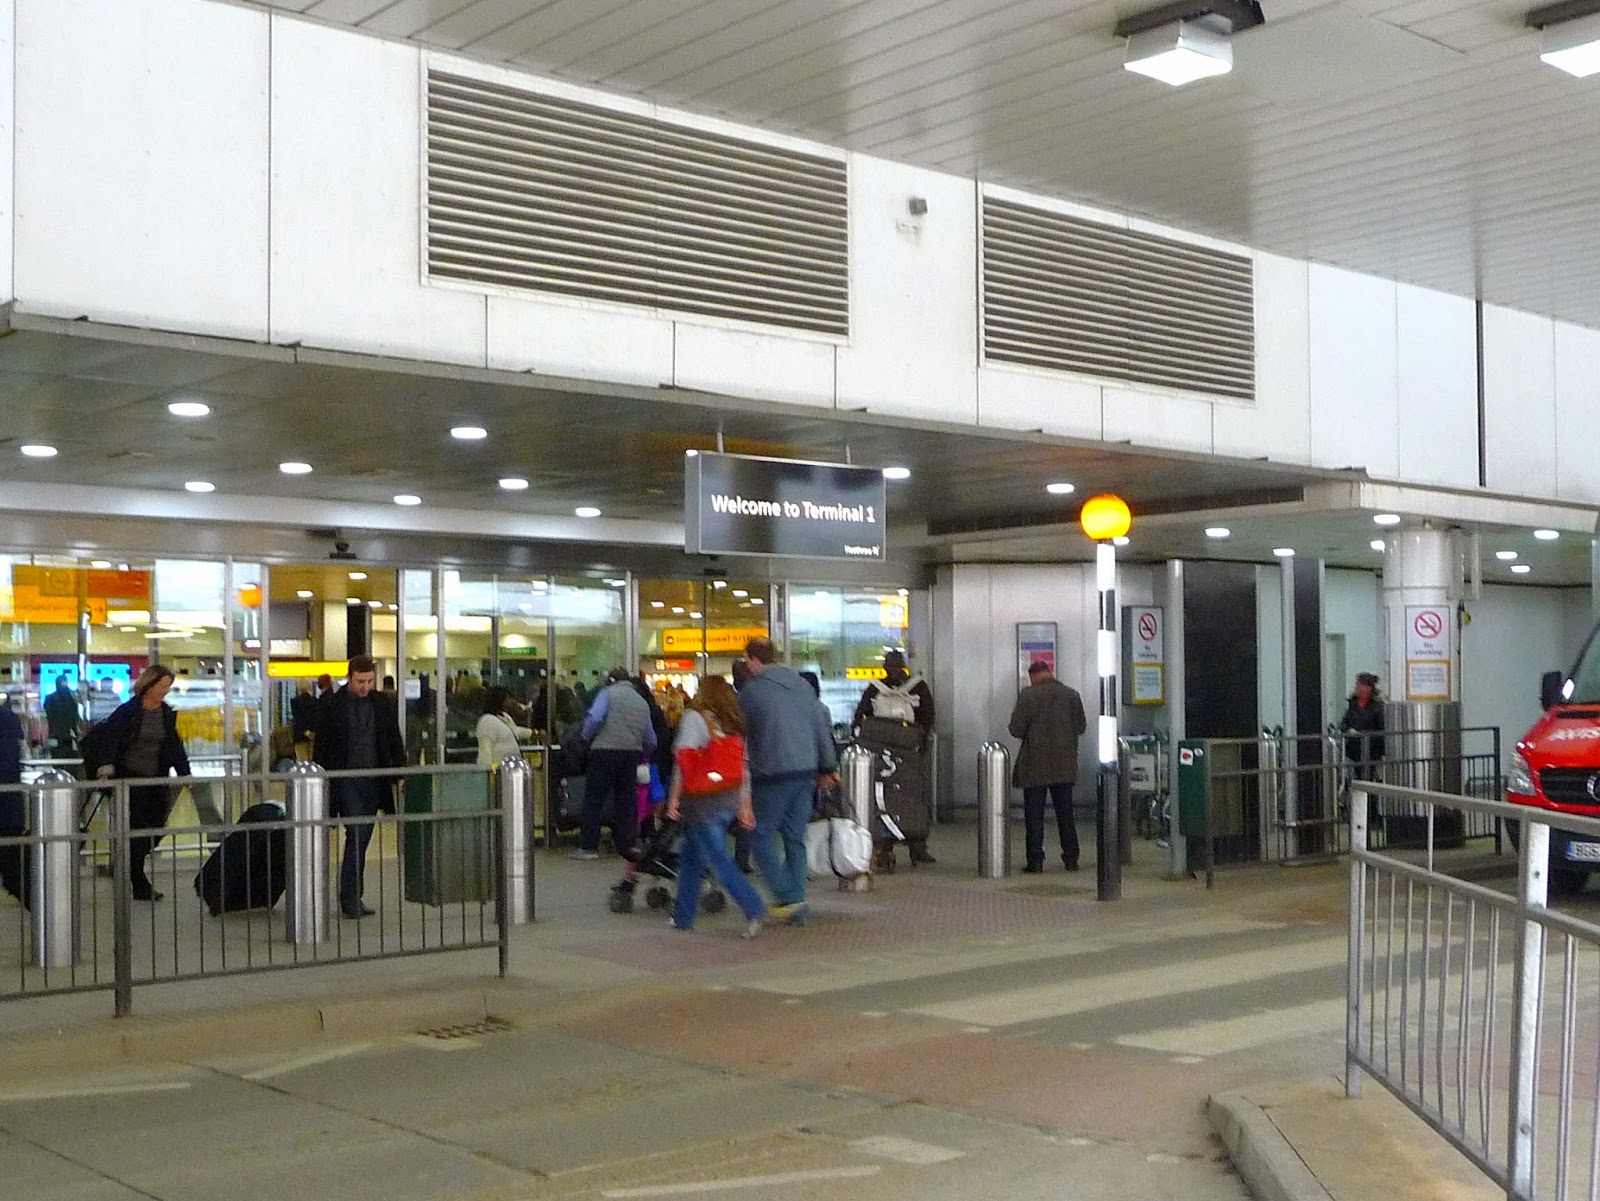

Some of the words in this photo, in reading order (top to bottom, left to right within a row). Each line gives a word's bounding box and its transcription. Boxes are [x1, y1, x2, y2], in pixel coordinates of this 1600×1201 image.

[711, 494, 781, 517] Welcome
[783, 500, 800, 518] to
[802, 500, 864, 523] Terminal
[866, 505, 876, 523] 1
